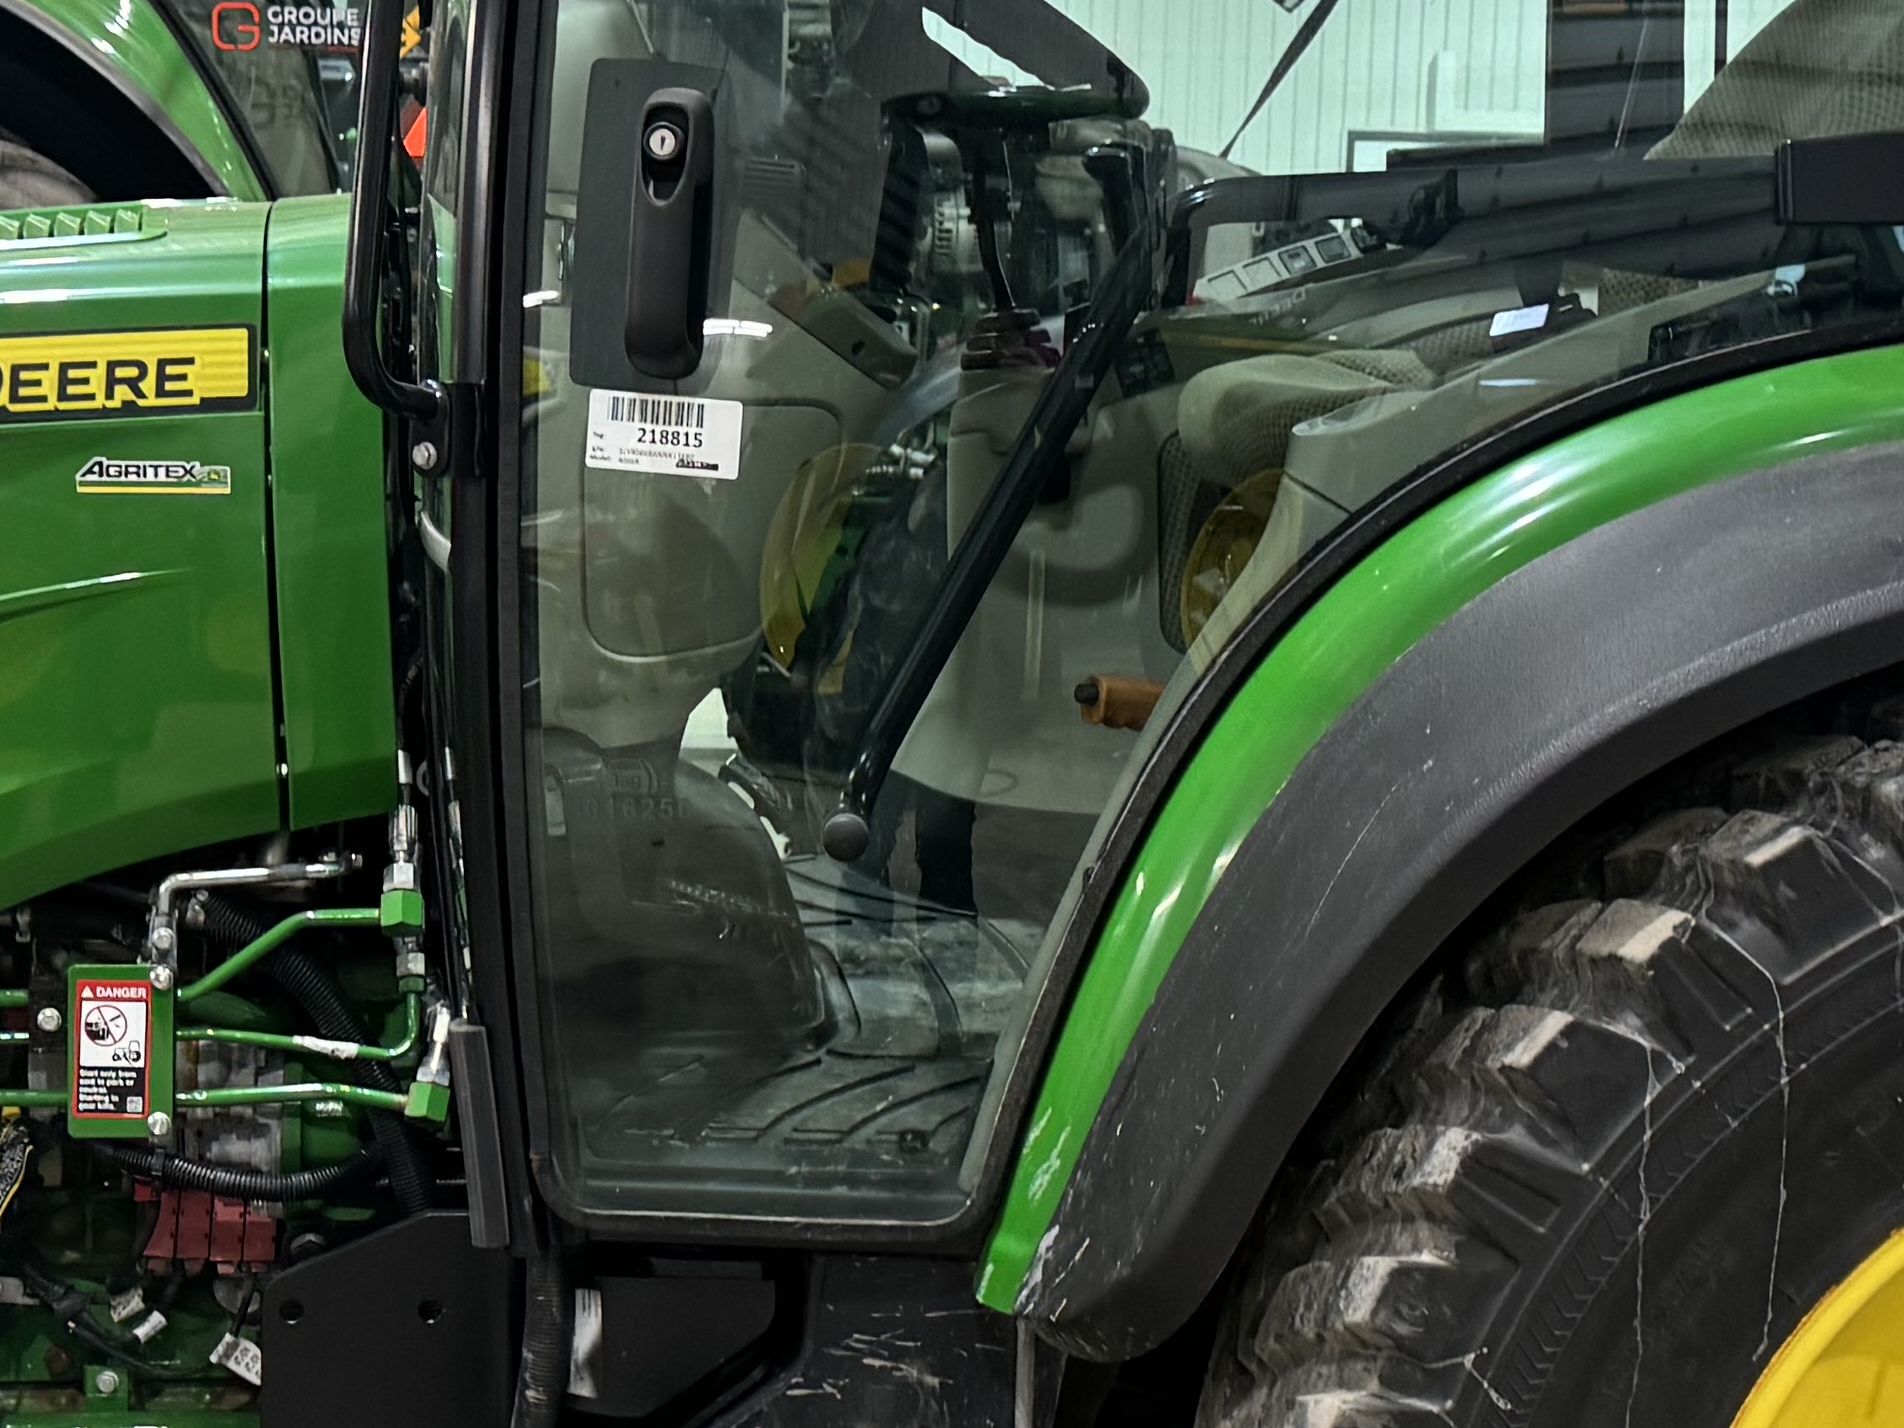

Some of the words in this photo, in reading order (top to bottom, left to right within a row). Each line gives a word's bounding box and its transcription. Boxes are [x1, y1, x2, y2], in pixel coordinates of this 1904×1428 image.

[267, 5, 360, 27] GROUPE
[637, 427, 703, 448] 218815
[80, 461, 196, 480] AGRITEX
[96, 987, 147, 998] DANGER
